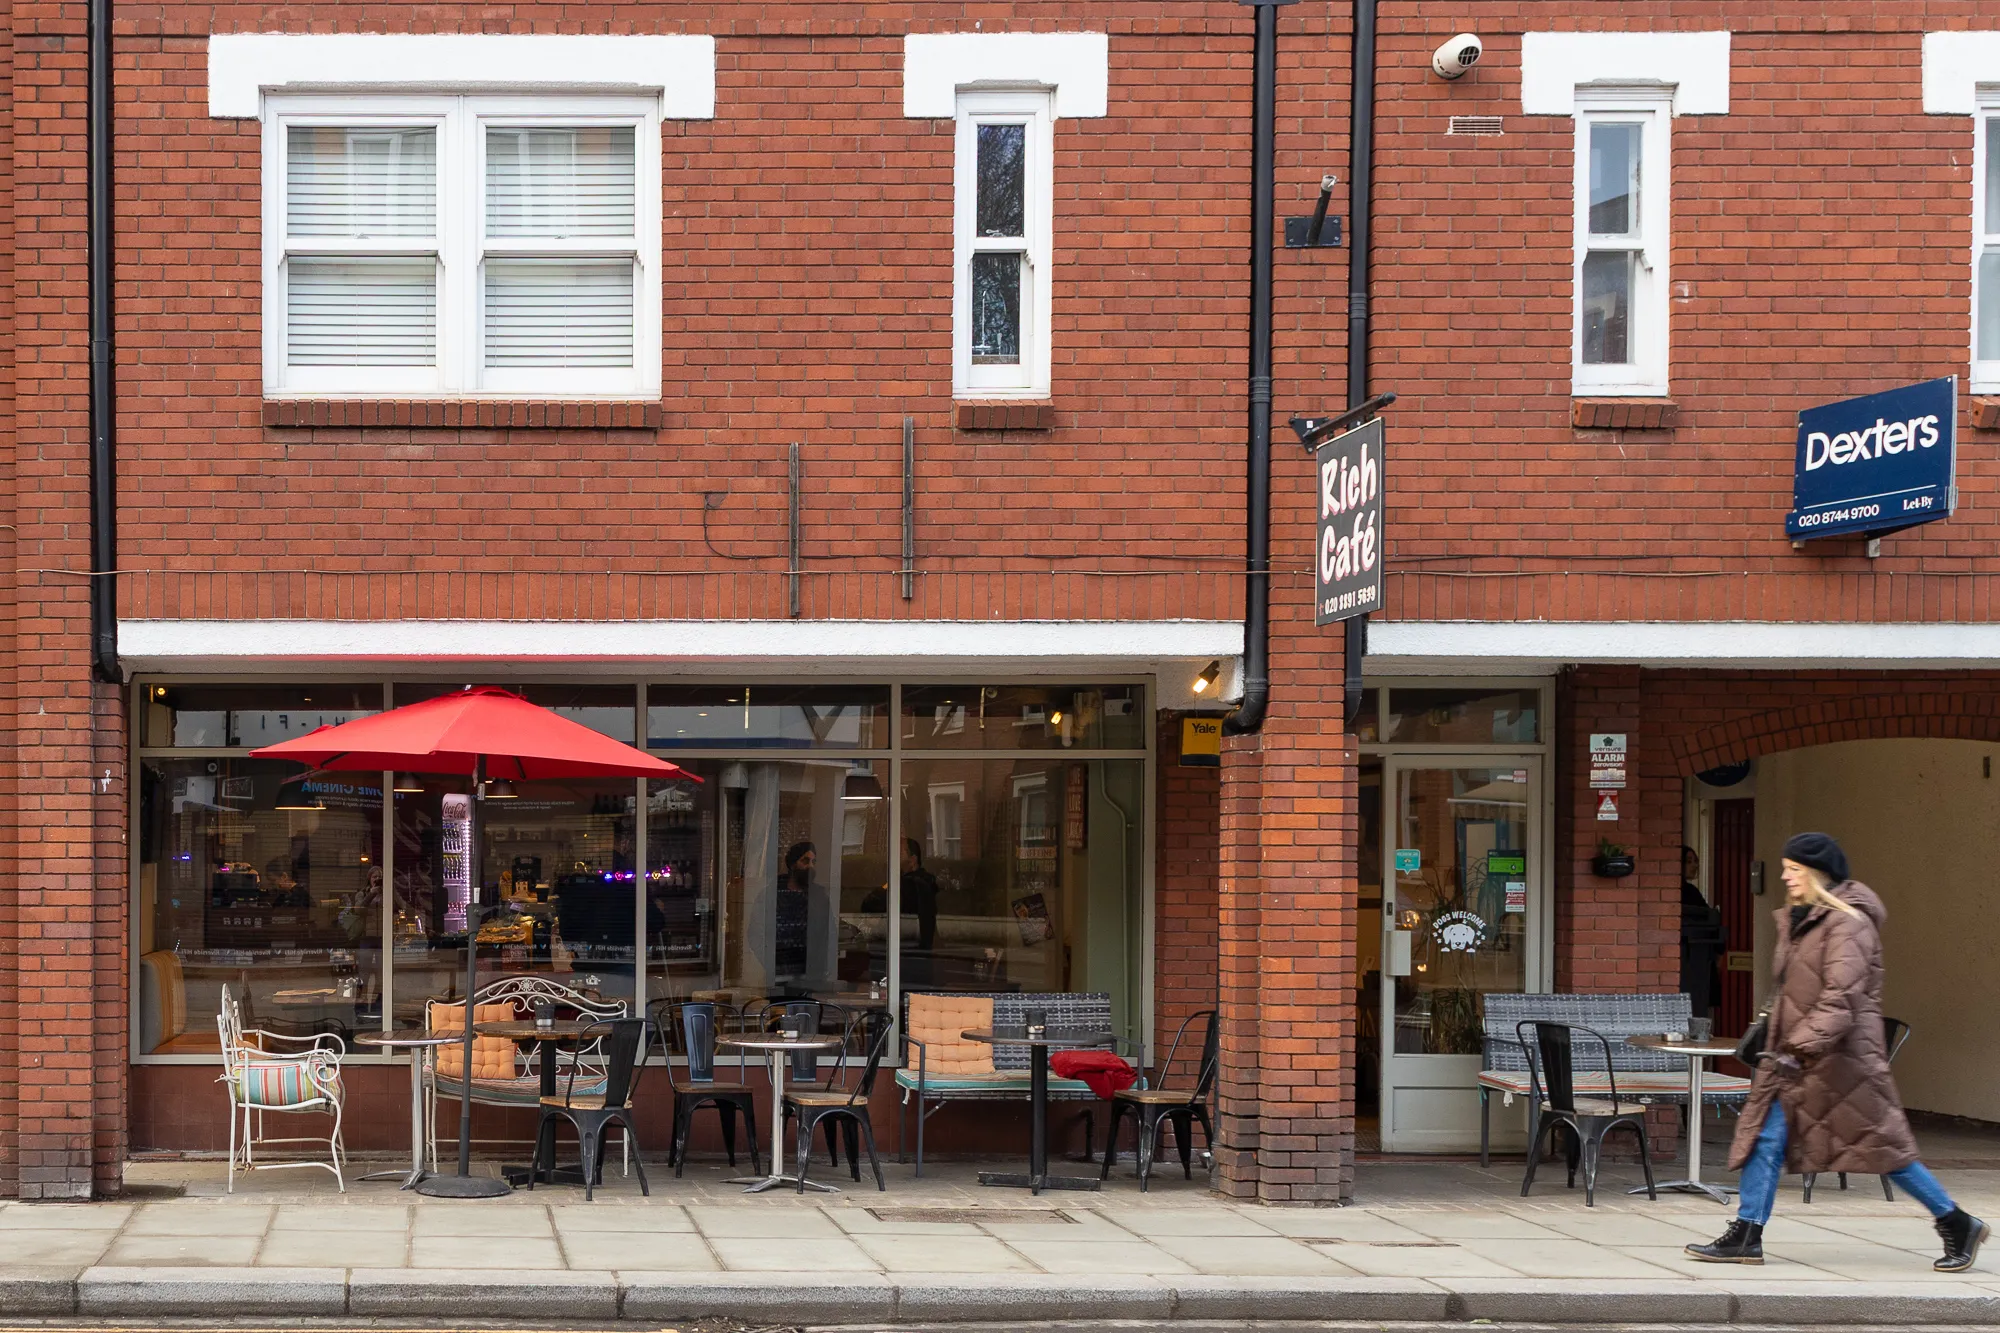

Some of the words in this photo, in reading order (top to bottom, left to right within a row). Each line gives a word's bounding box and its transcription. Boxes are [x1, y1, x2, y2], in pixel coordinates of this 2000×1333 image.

[1805, 414, 1939, 472] Dexters
[1320, 442, 1377, 520] Rich
[1798, 513, 1820, 527] 020
[1821, 509, 1850, 524] 8744
[1850, 504, 1880, 520] 9700
[1320, 509, 1376, 585] Café
[1325, 598, 1338, 615] 020
[1192, 722, 1217, 734] Yale
[1591, 753, 1625, 762] ALARM
[1432, 913, 1452, 929] DOGS
[1452, 911, 1487, 930] WELCOME
